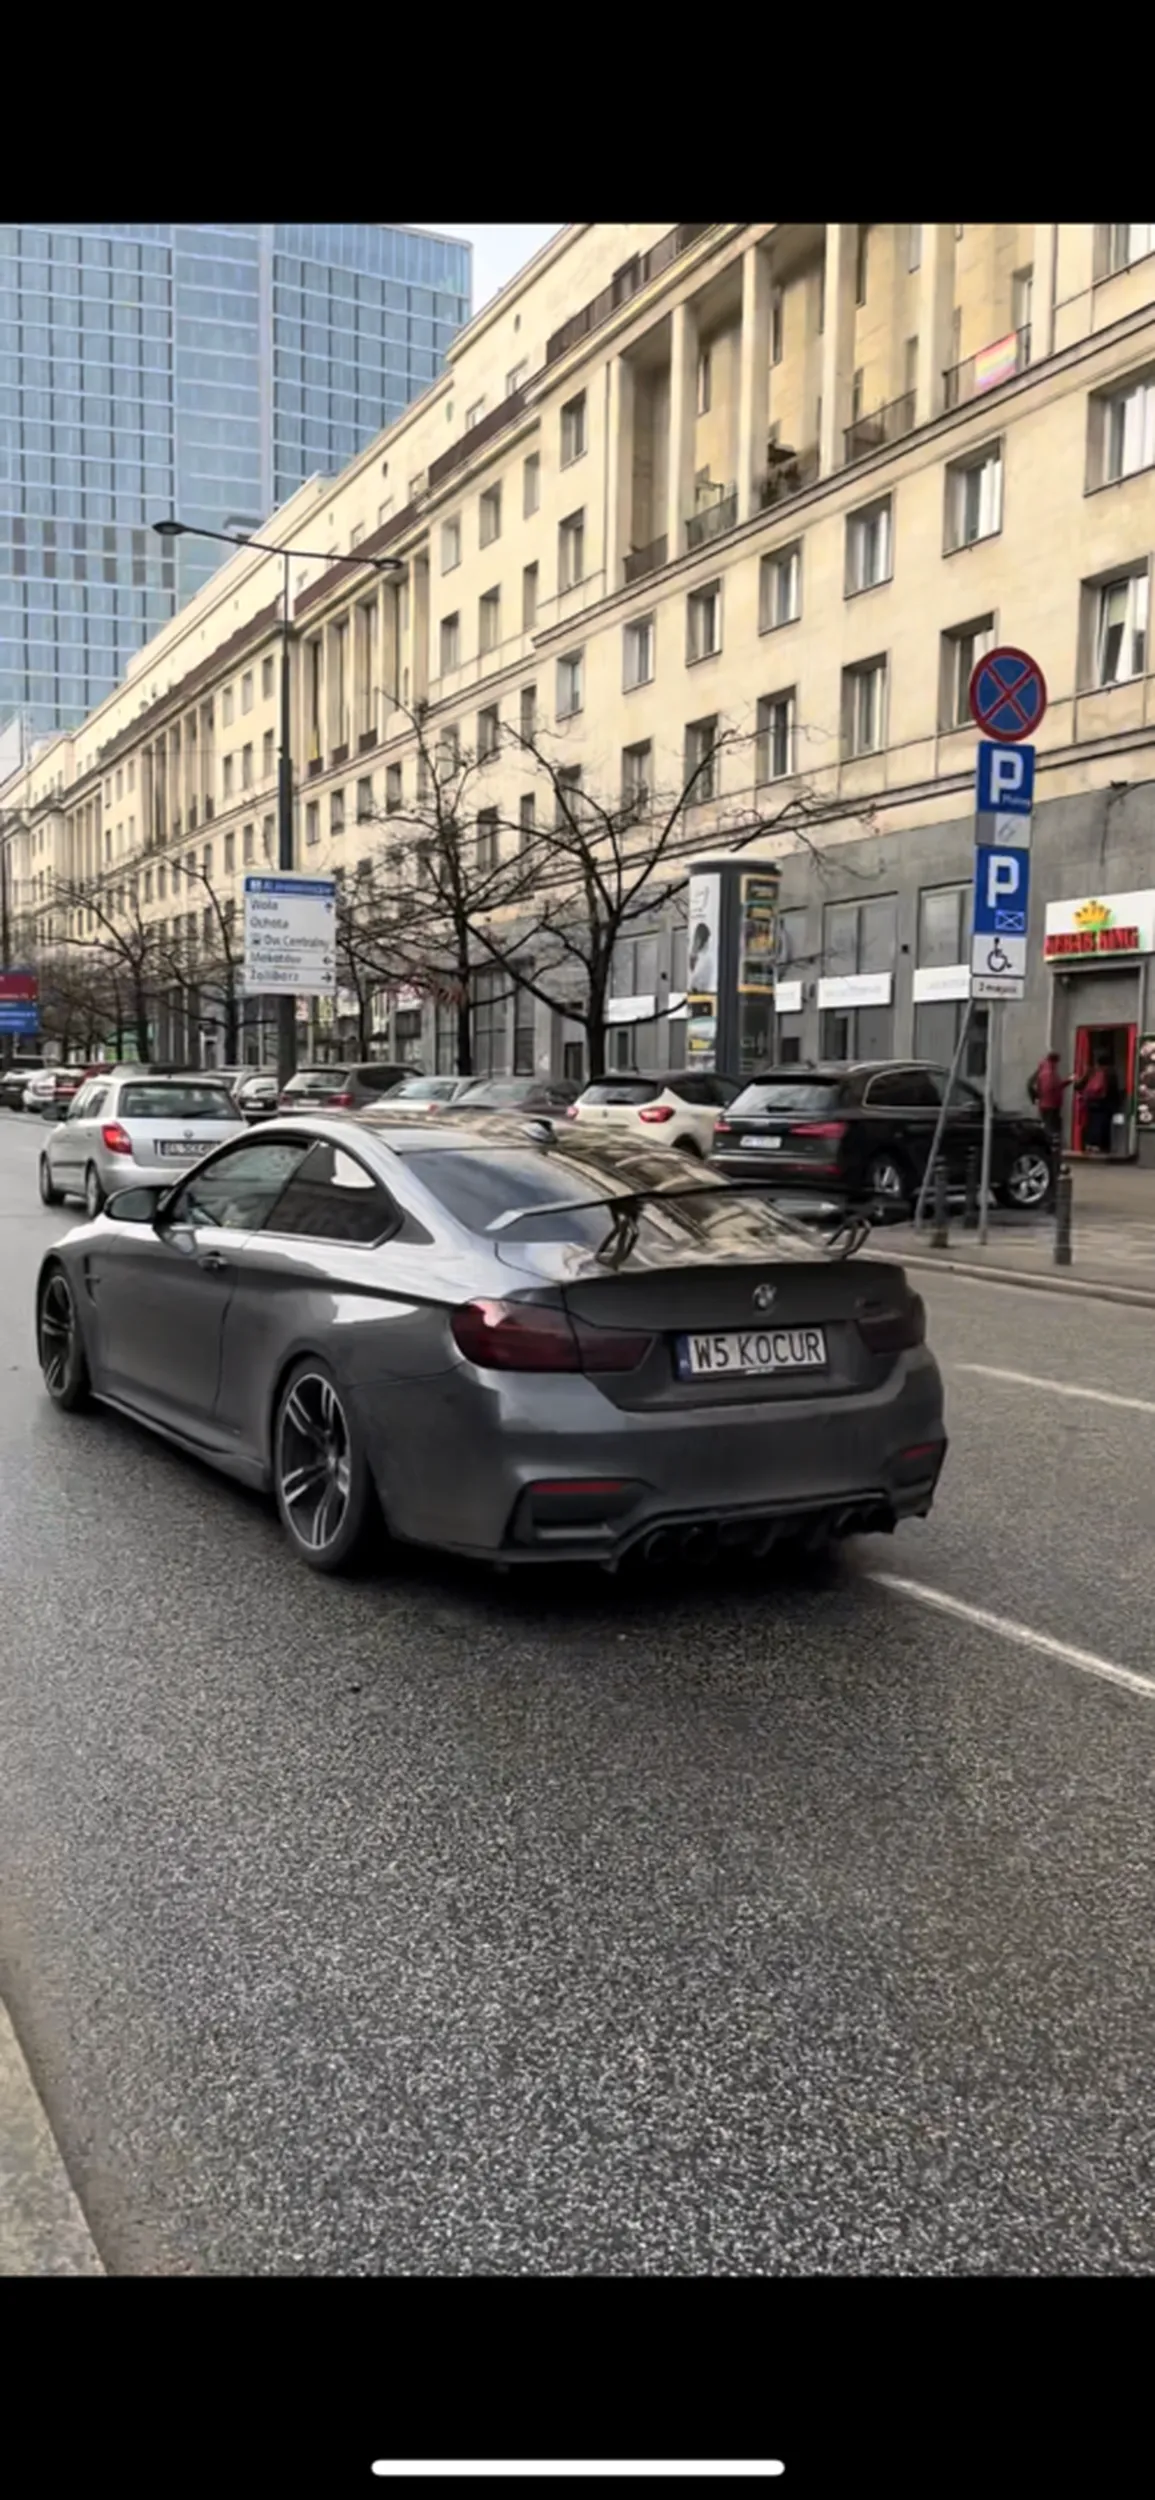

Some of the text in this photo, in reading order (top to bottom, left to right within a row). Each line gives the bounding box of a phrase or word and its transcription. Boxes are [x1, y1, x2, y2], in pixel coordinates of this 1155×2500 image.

[990, 749, 1024, 803] P
[987, 855, 1020, 908] P
[249, 916, 290, 930] Ochota
[250, 899, 279, 911] Wola
[694, 1331, 822, 1369] W5 KOCUR
